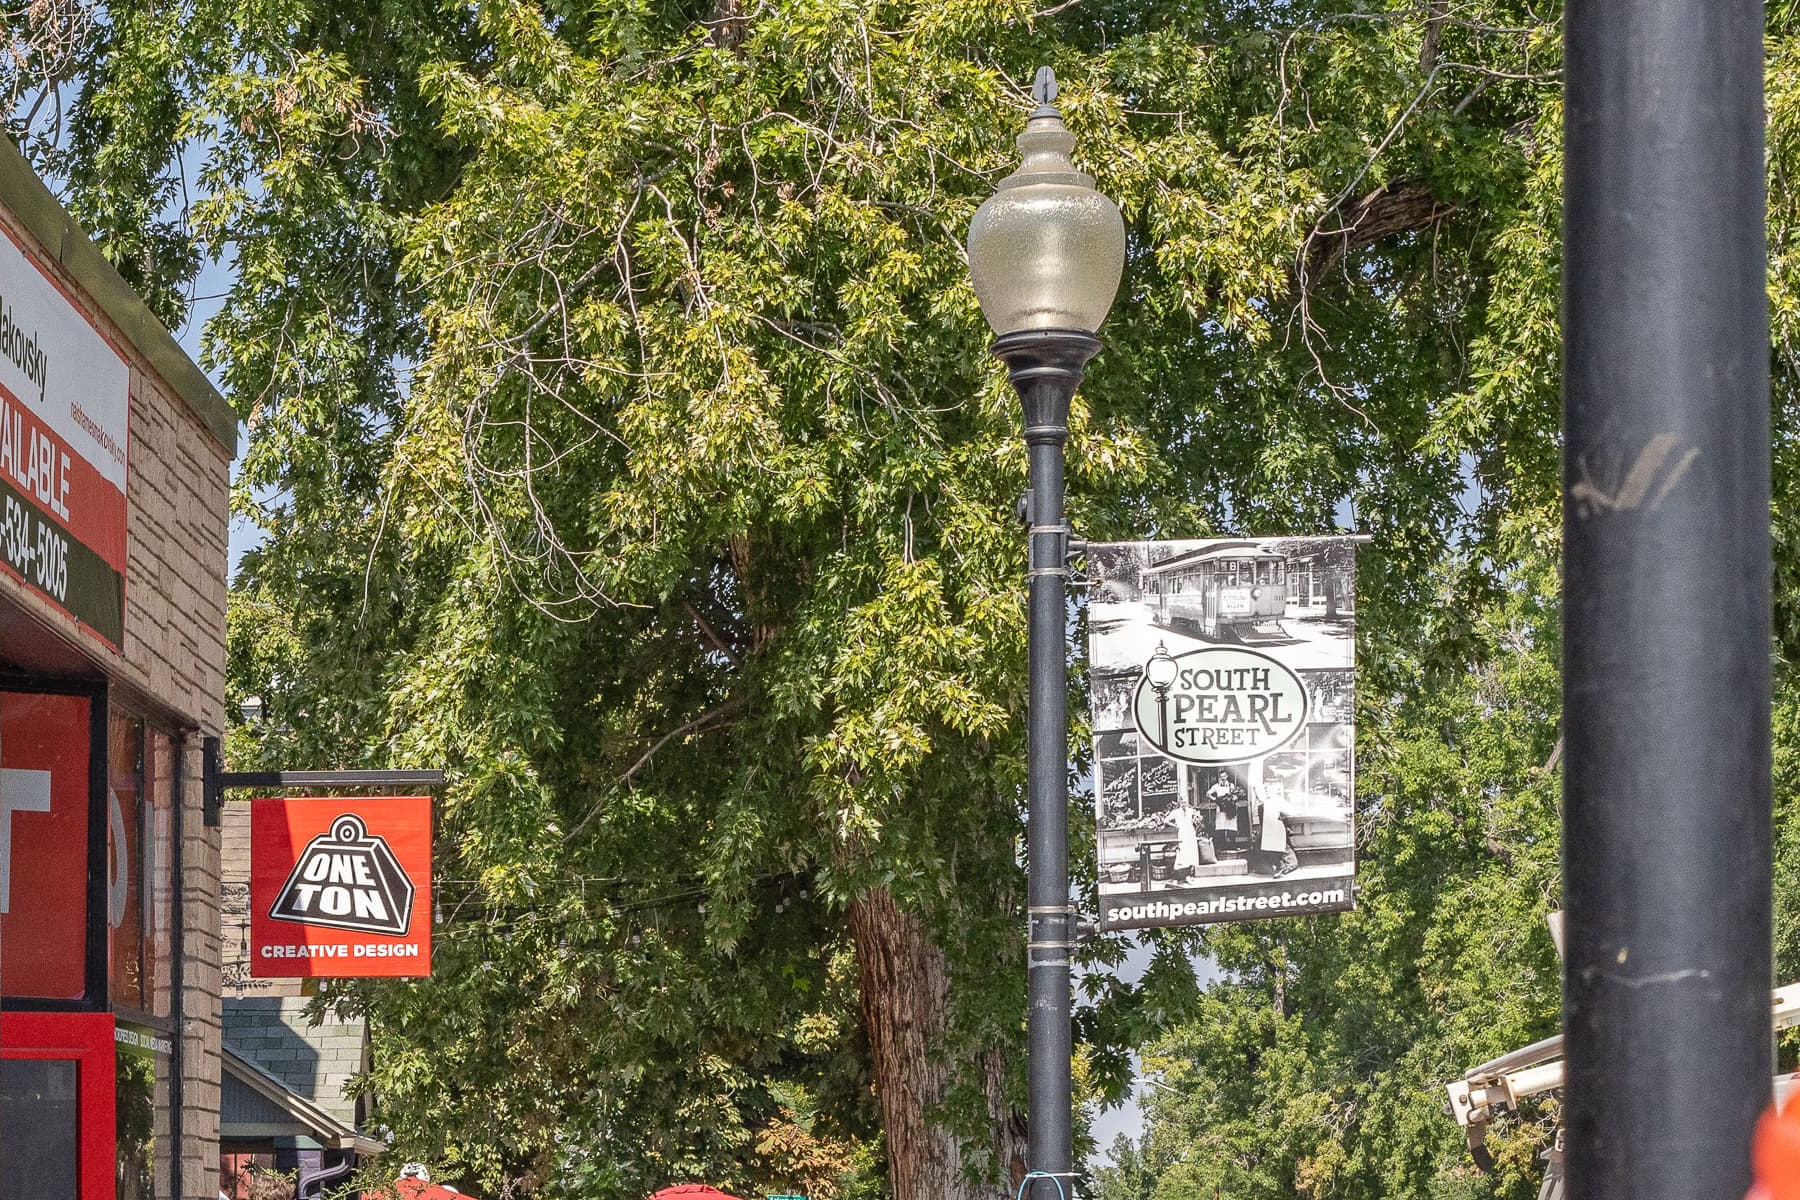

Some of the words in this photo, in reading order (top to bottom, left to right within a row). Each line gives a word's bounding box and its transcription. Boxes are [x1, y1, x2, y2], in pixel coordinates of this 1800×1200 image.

[1180, 668, 1270, 691] SOUTH
[1173, 693, 1292, 735] PEARL
[1175, 728, 1260, 750] STREET
[303, 853, 376, 886] ONE
[292, 884, 389, 921] TON
[1107, 889, 1345, 921] southpearlstreet.com
[261, 944, 348, 958] CREATIVE
[354, 944, 419, 958] DESIGN
